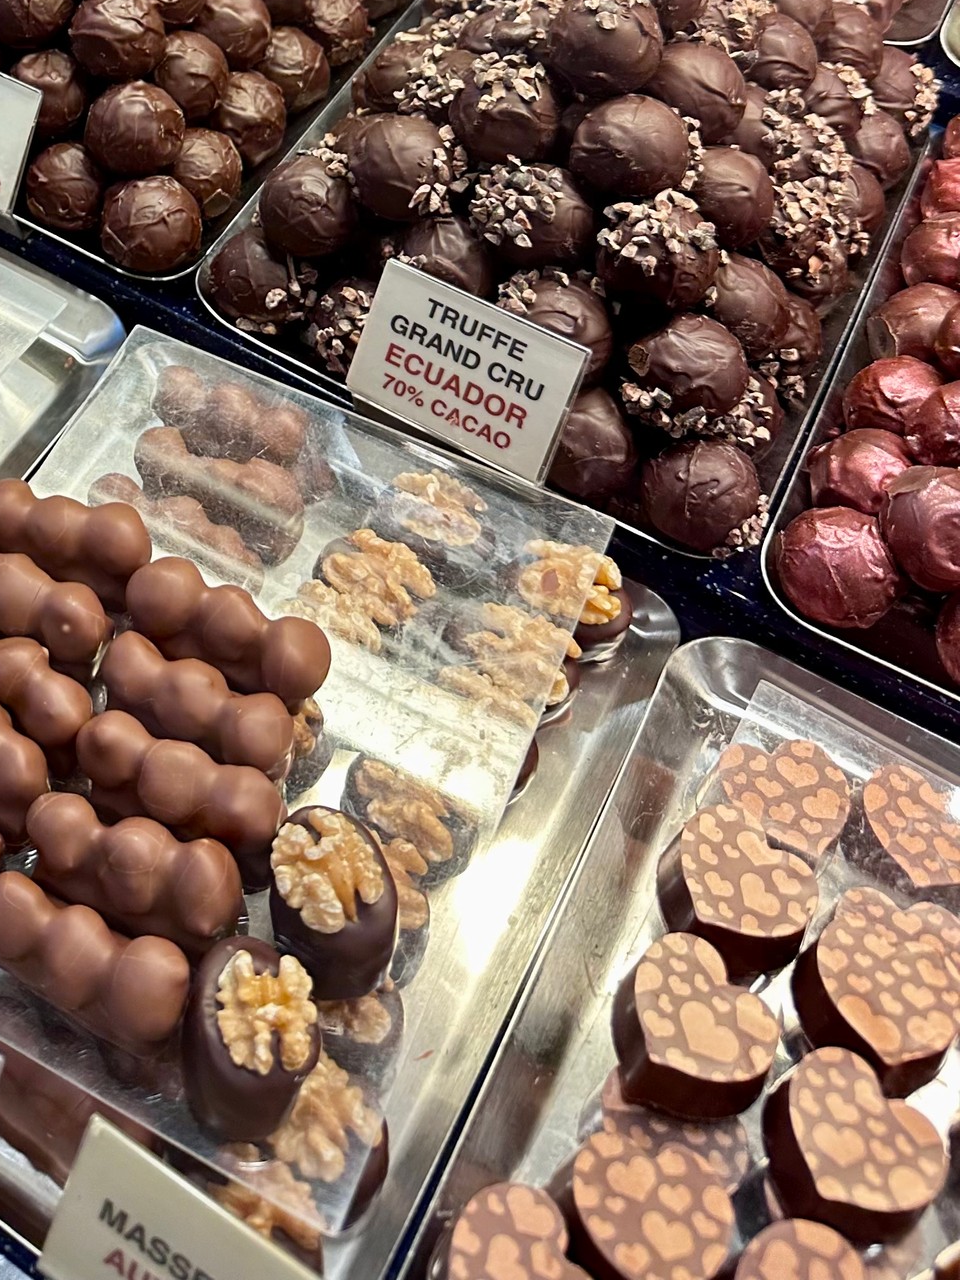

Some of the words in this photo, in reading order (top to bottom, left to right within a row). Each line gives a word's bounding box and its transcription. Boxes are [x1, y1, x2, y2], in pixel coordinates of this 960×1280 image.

[390, 314, 481, 370] GRAND
[487, 361, 545, 402] CRU
[427, 297, 528, 362] TRUFFE
[381, 372, 425, 408] 70%
[430, 398, 512, 450] CACAO
[384, 342, 528, 429] ECUADOR
